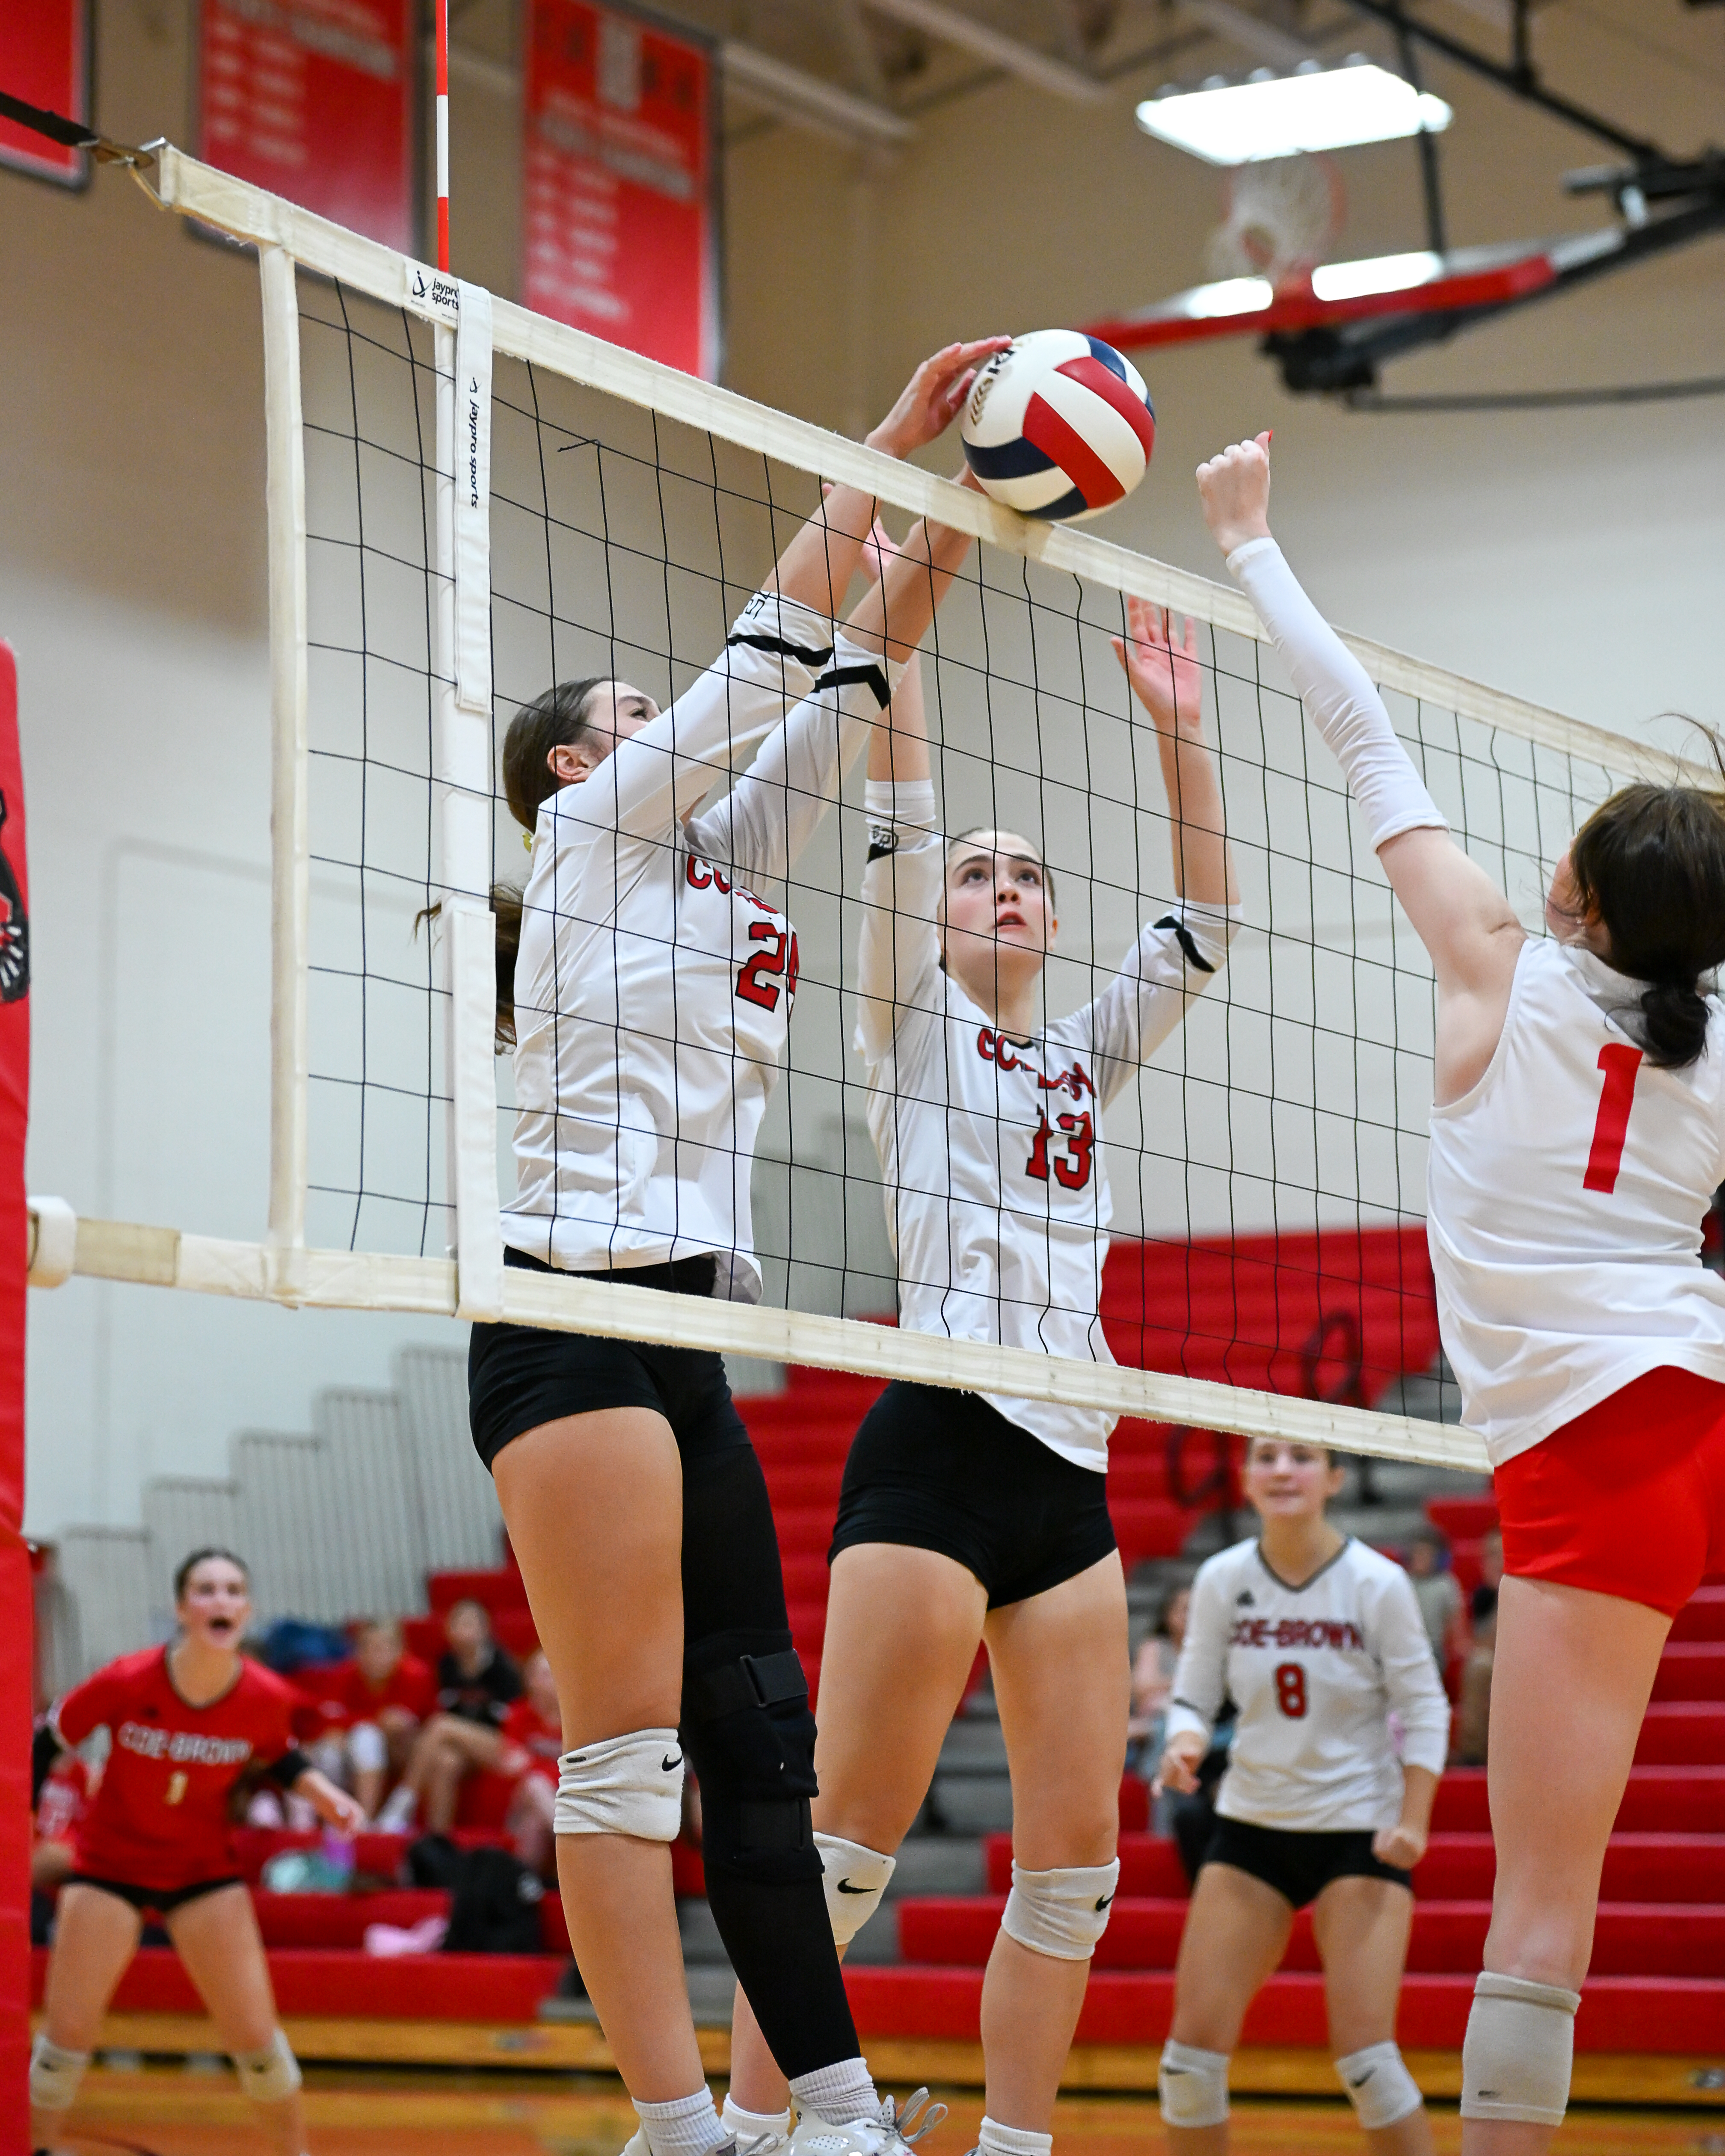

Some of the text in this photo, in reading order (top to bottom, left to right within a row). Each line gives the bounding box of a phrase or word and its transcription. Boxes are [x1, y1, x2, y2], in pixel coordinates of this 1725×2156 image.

[432, 292, 459, 311] sports
[469, 399, 480, 509] jaypro sports
[1025, 1103, 1094, 1191] 13
[1583, 1042, 1644, 1195] 1
[1275, 1661, 1308, 1719] 8
